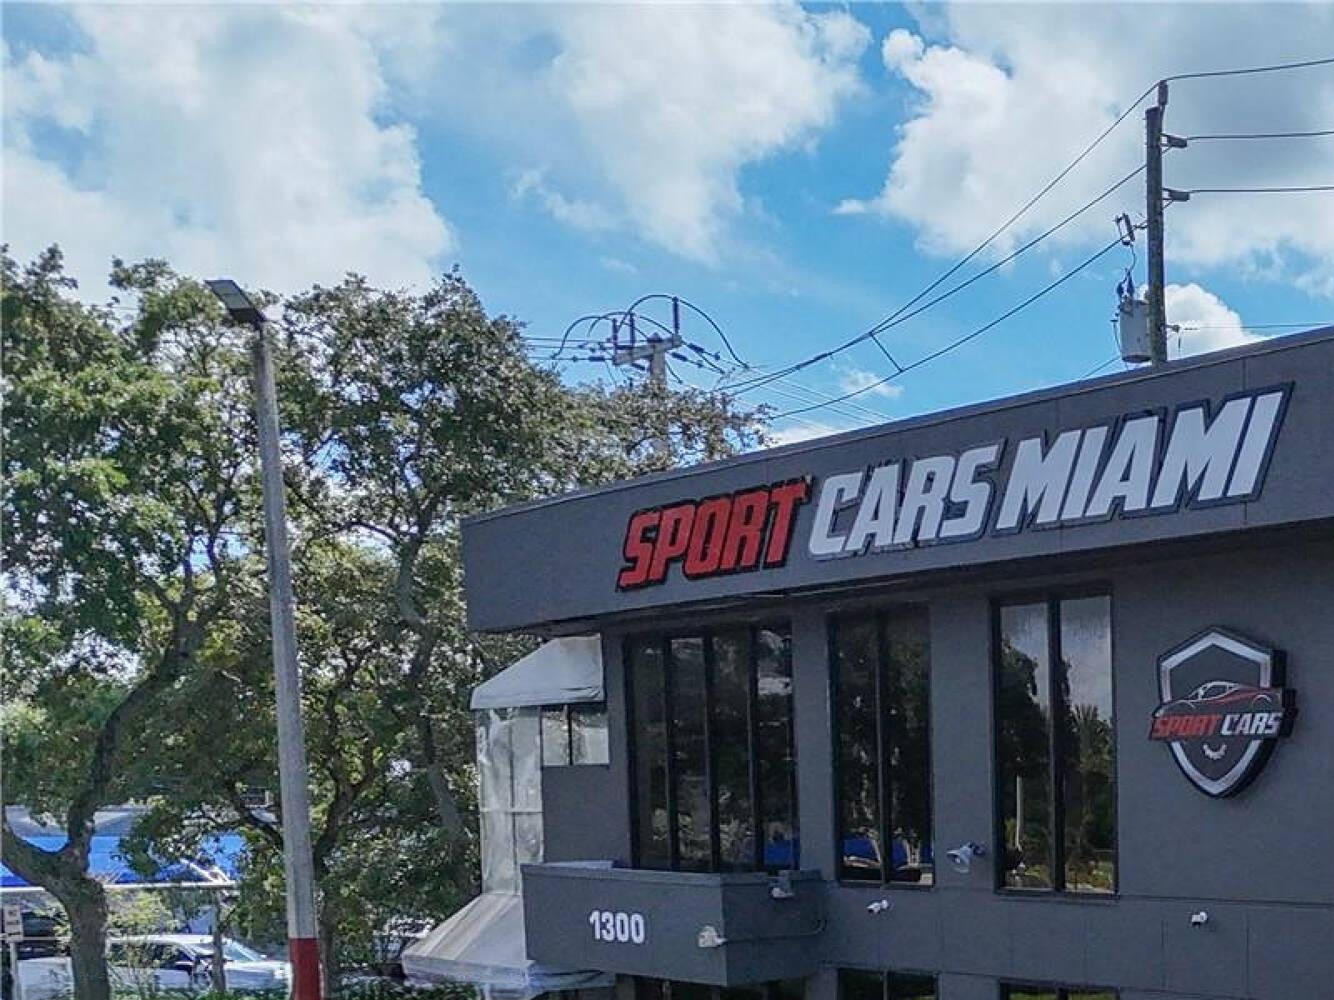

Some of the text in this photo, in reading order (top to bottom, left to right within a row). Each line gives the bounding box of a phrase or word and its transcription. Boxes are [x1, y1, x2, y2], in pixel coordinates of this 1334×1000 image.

[618, 390, 1286, 588] SPORT CARS MIAMI
[1152, 711, 1283, 738] SPORT CARS
[589, 909, 646, 945] 1300
